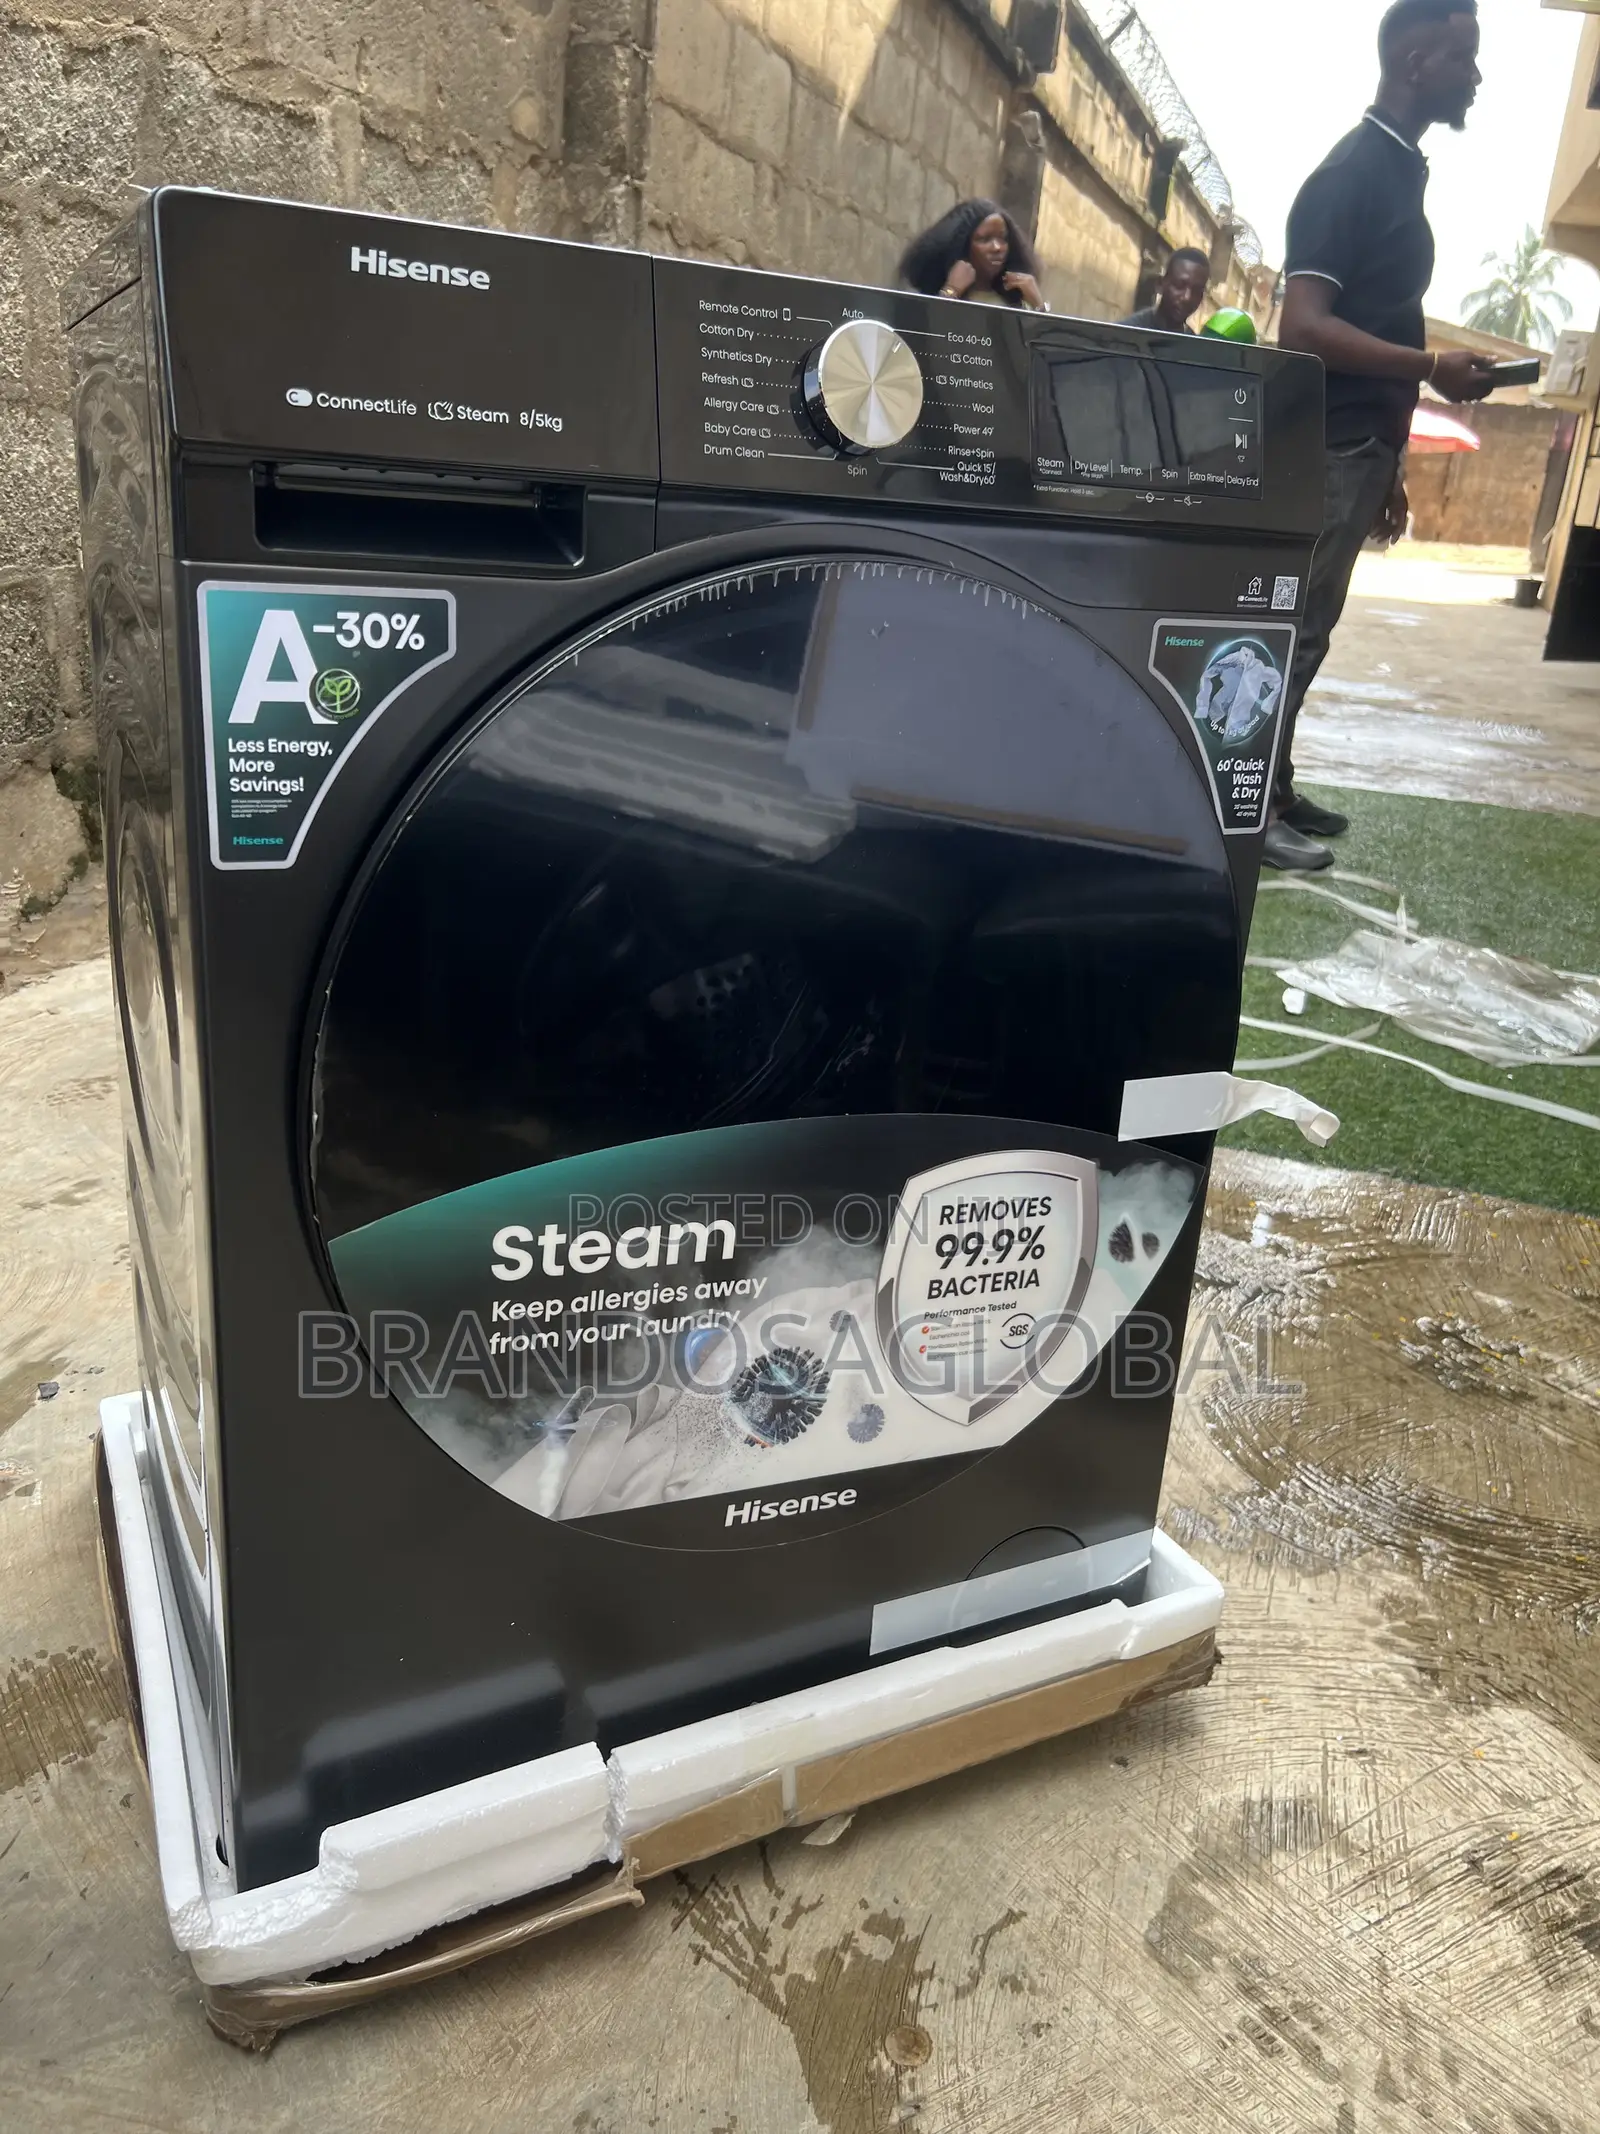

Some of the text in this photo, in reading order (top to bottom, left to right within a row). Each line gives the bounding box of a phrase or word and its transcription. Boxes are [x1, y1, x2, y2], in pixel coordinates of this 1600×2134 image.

[351, 246, 490, 290] Hisense
[699, 300, 778, 319] Remote Control
[841, 307, 864, 319] Auto
[699, 323, 754, 341] Cotton Dry
[947, 332, 992, 347] Eco 40-60
[701, 347, 772, 367] Synthetics Dry
[962, 353, 993, 367] Cotton
[701, 372, 739, 386] Refresh
[949, 376, 994, 391] Synthetics
[316, 393, 417, 416] ConnectLife
[704, 396, 764, 413] Allergy Care
[972, 403, 994, 414] Wool
[456, 406, 509, 424] Steam
[519, 409, 563, 432] 8/5kg
[704, 422, 757, 437] Baby Care
[953, 423, 981, 435] Power
[704, 444, 765, 459] Drum Clean
[948, 445, 995, 459] Rinse+Spin
[957, 462, 982, 473] Quick
[1037, 457, 1064, 468] Steam
[1075, 461, 1109, 473] Dry Level
[847, 465, 868, 477] Spin
[1120, 465, 1143, 476] Temp.
[1162, 469, 1178, 480] Spin
[1190, 472, 1224, 483] Extra Rinse
[1227, 475, 1259, 487] Delay End
[1165, 636, 1204, 647] Hisense
[228, 609, 425, 724] A -30%
[228, 738, 332, 757] Less Energy,
[229, 758, 275, 772] More
[1234, 758, 1264, 771] Quick
[230, 776, 304, 795] Savings!
[1233, 773, 1262, 785] Wash
[1232, 787, 1260, 801] & Dry
[233, 836, 283, 845] Hisense
[939, 1196, 1052, 1225] REMOVES
[491, 1219, 736, 1281] Steam
[935, 1225, 1045, 1269] 99.9%
[927, 1268, 1040, 1299] BACTERIA
[492, 1276, 767, 1322] Keep allergies away
[924, 1301, 1017, 1320] Performance Tested
[489, 1309, 740, 1354] from your laundry
[1009, 1324, 1029, 1337] SGS
[725, 1488, 857, 1527] Hisense
